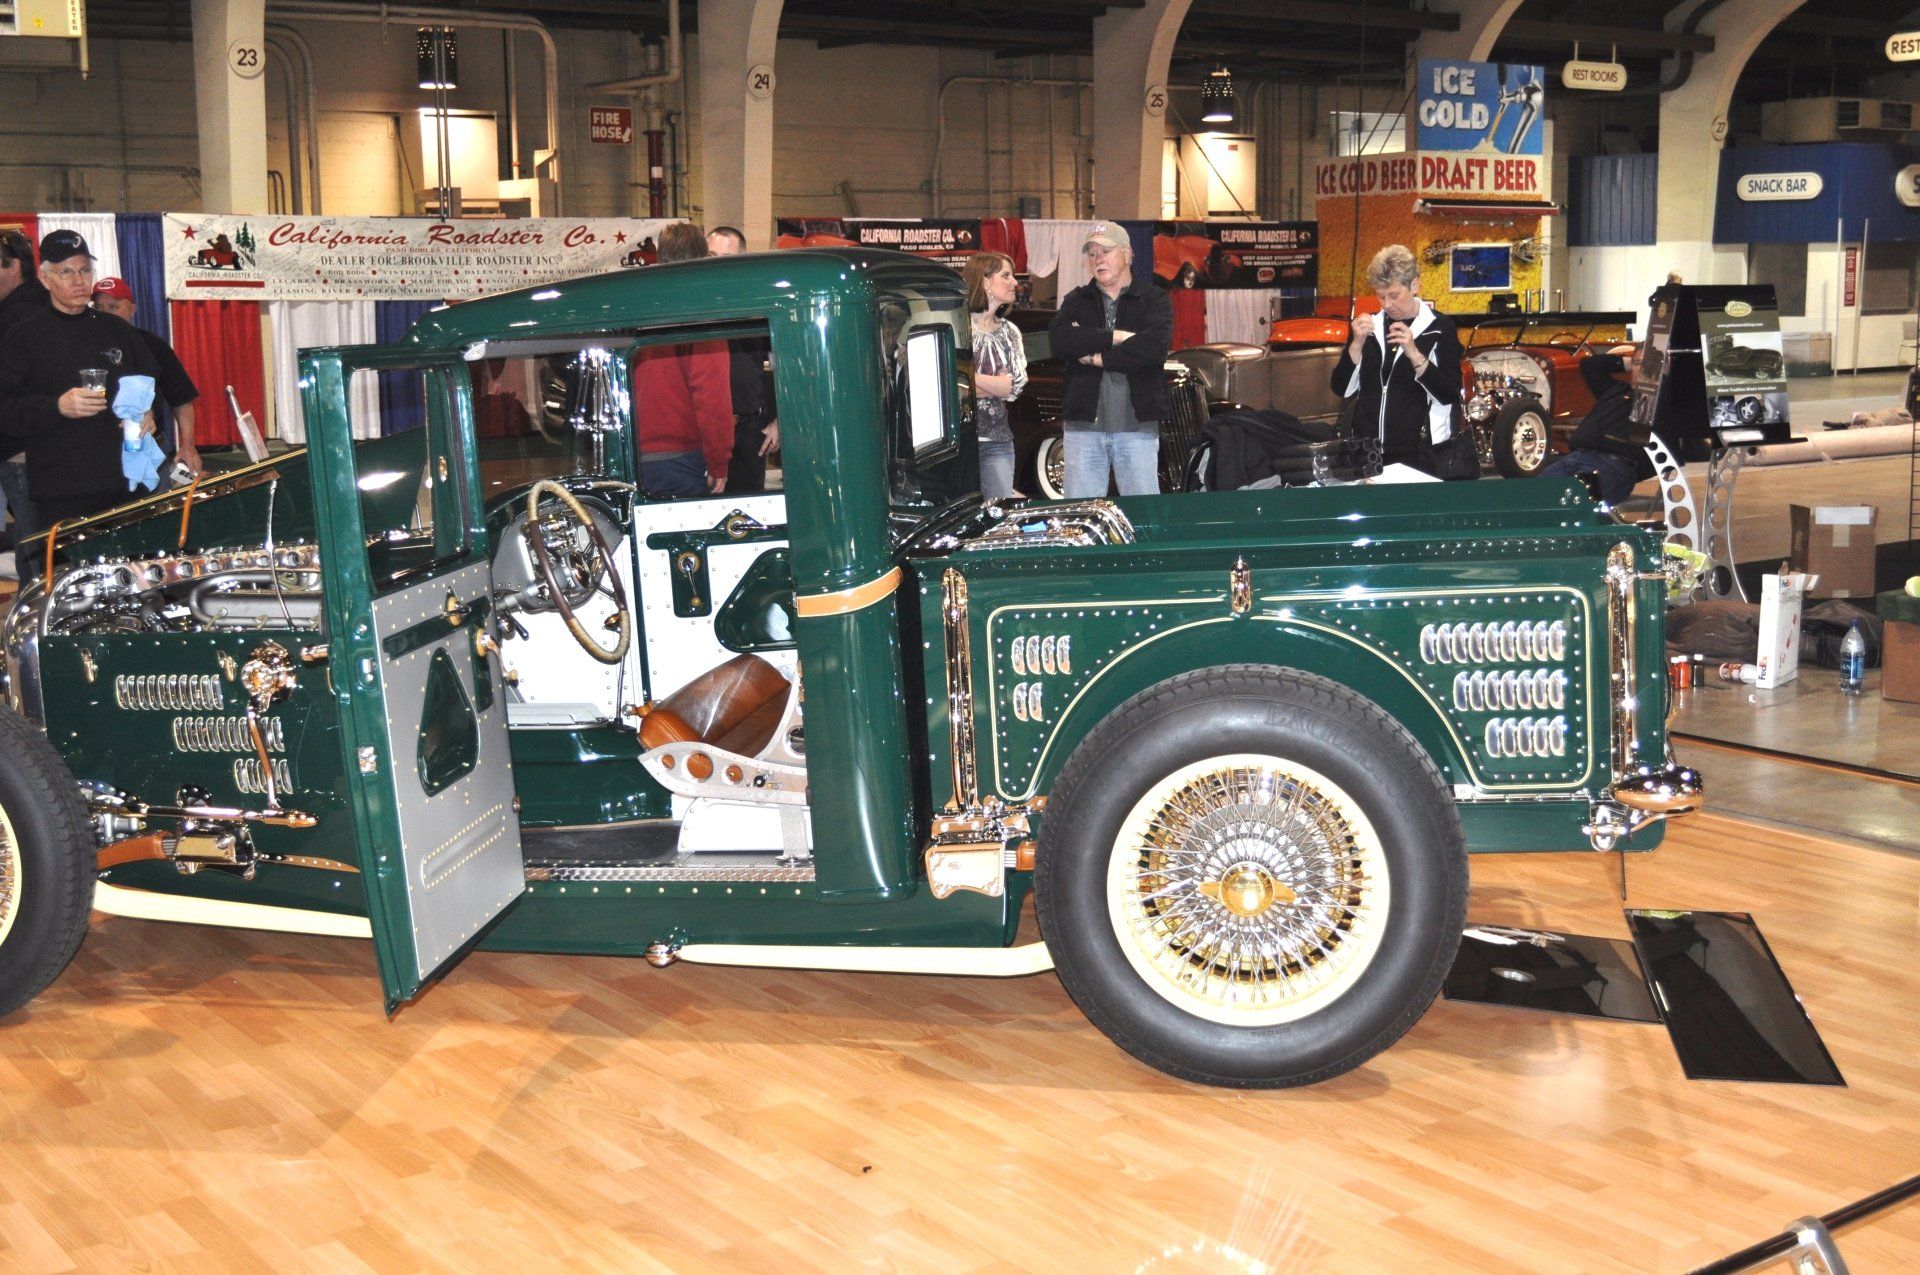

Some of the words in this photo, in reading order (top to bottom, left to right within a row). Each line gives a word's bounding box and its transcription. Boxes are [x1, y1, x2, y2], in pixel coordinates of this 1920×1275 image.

[1891, 39, 1920, 54] REST
[237, 48, 258, 67] 23
[754, 73, 770, 90] 24
[1433, 66, 1476, 96] ICE
[1572, 69, 1588, 81] REST
[1590, 70, 1618, 83] ROOMS
[1151, 93, 1164, 108] 25
[593, 111, 620, 125] FIRE
[1419, 99, 1490, 130] COLD
[592, 126, 622, 139] HOSE
[1716, 121, 1726, 134] 27
[1316, 163, 1336, 195] ICE
[1339, 161, 1378, 193] COLD
[1380, 157, 1417, 191] BEER
[1421, 156, 1489, 190] DRAFT
[1493, 159, 1538, 191] BEER
[1748, 179, 1783, 193] SNACK
[1786, 178, 1808, 193] BAR
[268, 222, 409, 249] California
[428, 224, 545, 246] Roadster
[563, 225, 606, 248] Co.
[860, 228, 902, 243] CALIFORNIA
[904, 228, 942, 243] ROADSTER
[1220, 229, 1257, 243] CALIFORNIA
[1258, 230, 1289, 243] ROADSTER
[321, 256, 365, 266] DEALER
[401, 256, 472, 266] BROOKVILLE
[476, 256, 532, 266] ROADSTER
[1758, 656, 1768, 680] FedEx
